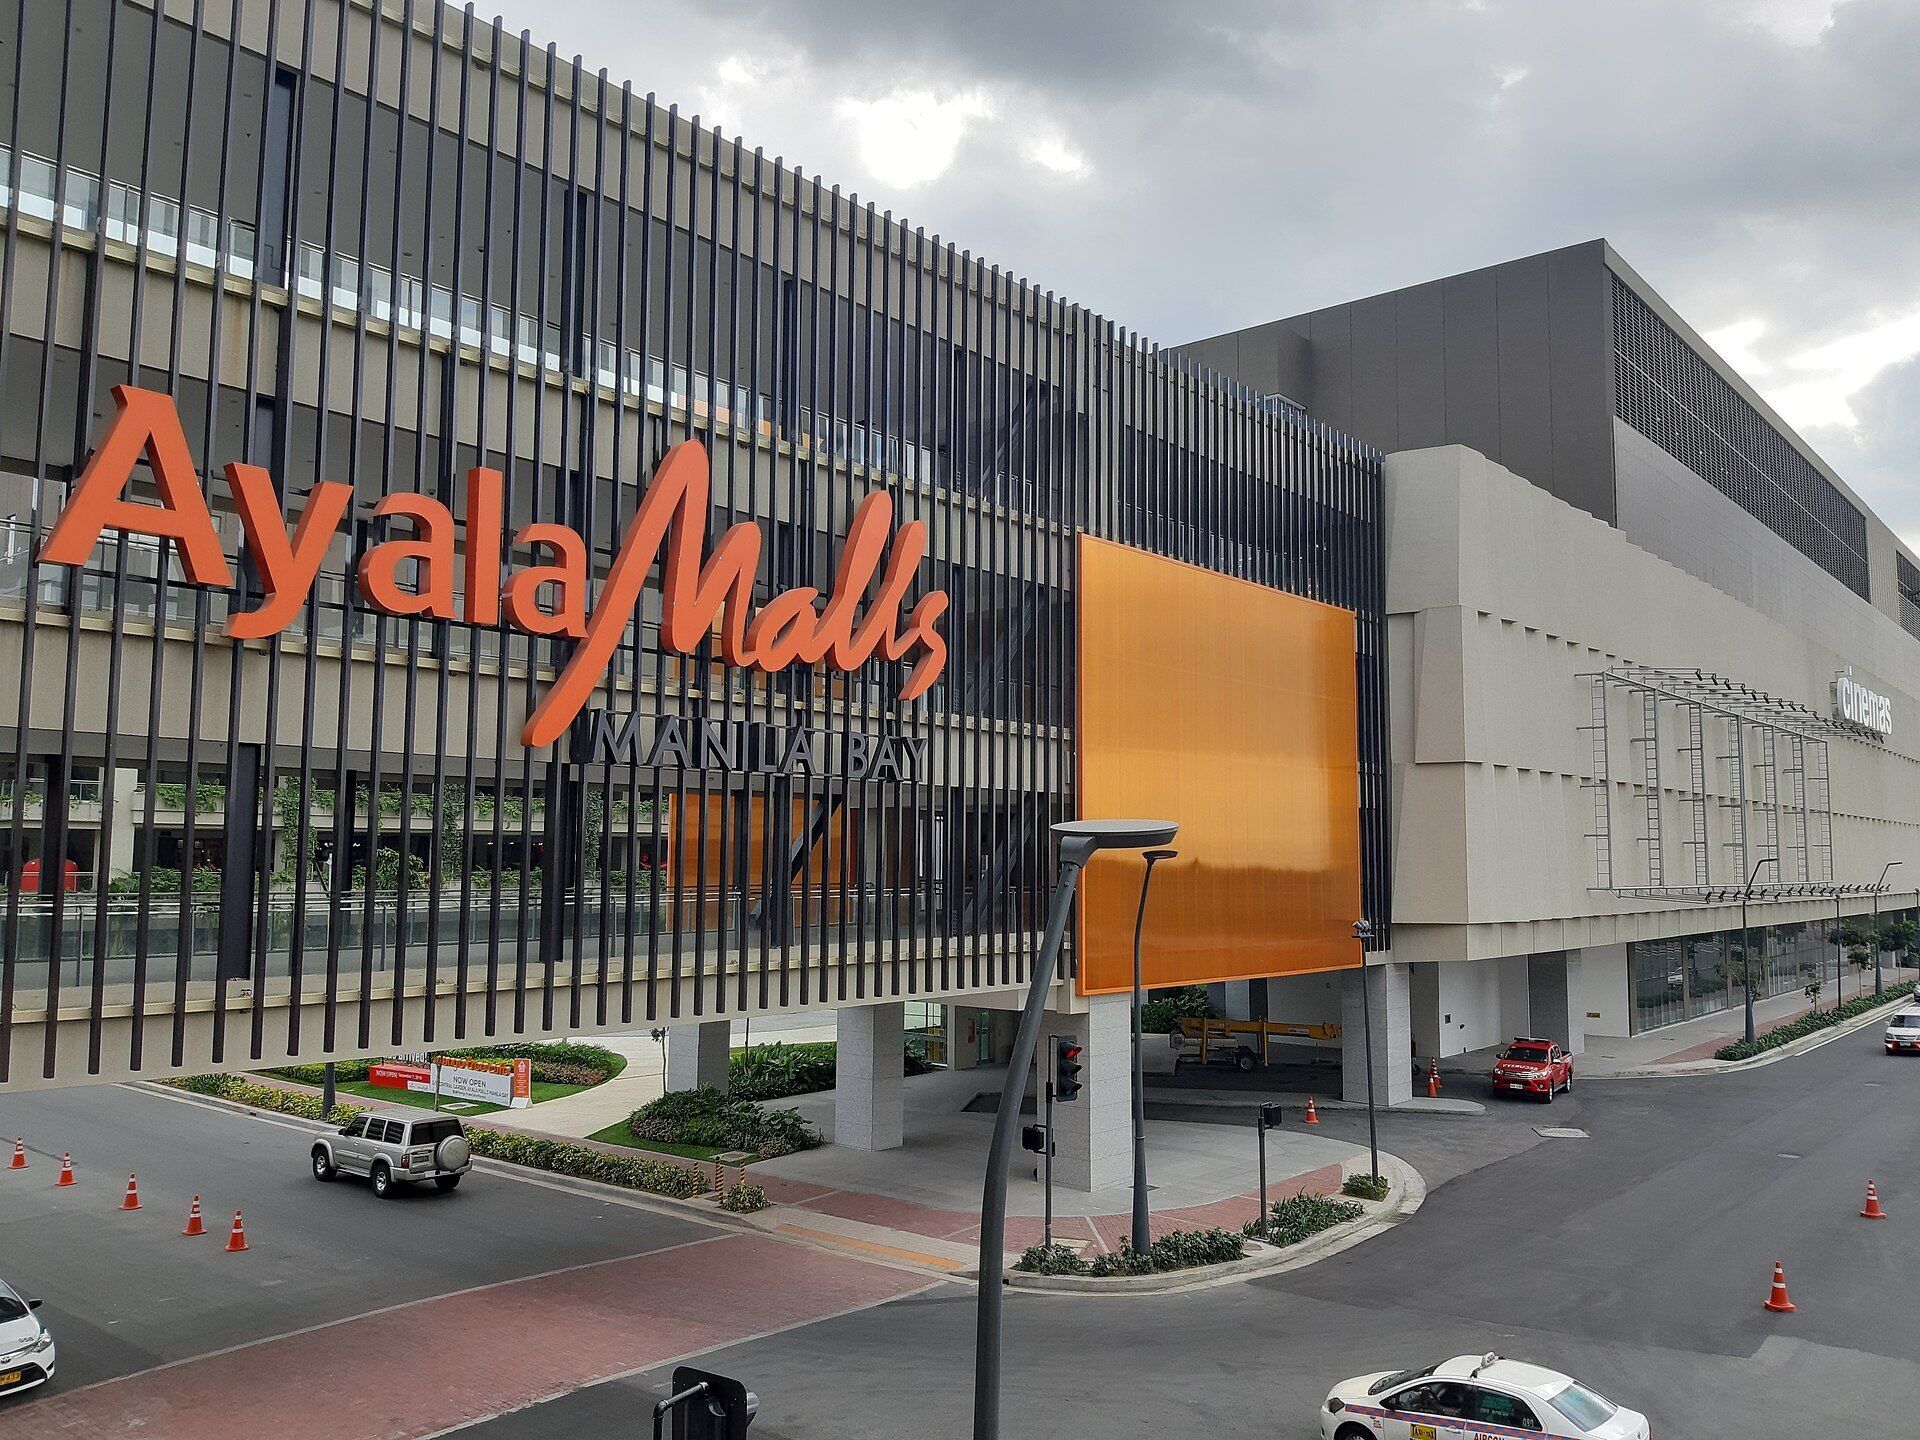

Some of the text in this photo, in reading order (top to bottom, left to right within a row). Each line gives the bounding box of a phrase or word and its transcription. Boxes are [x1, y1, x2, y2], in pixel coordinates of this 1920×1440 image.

[36, 384, 950, 748] Ayala Malls
[1837, 665, 1893, 735] cinemas
[586, 708, 928, 782] MANILA BAY
[453, 1076, 486, 1088] NOW OPEN
